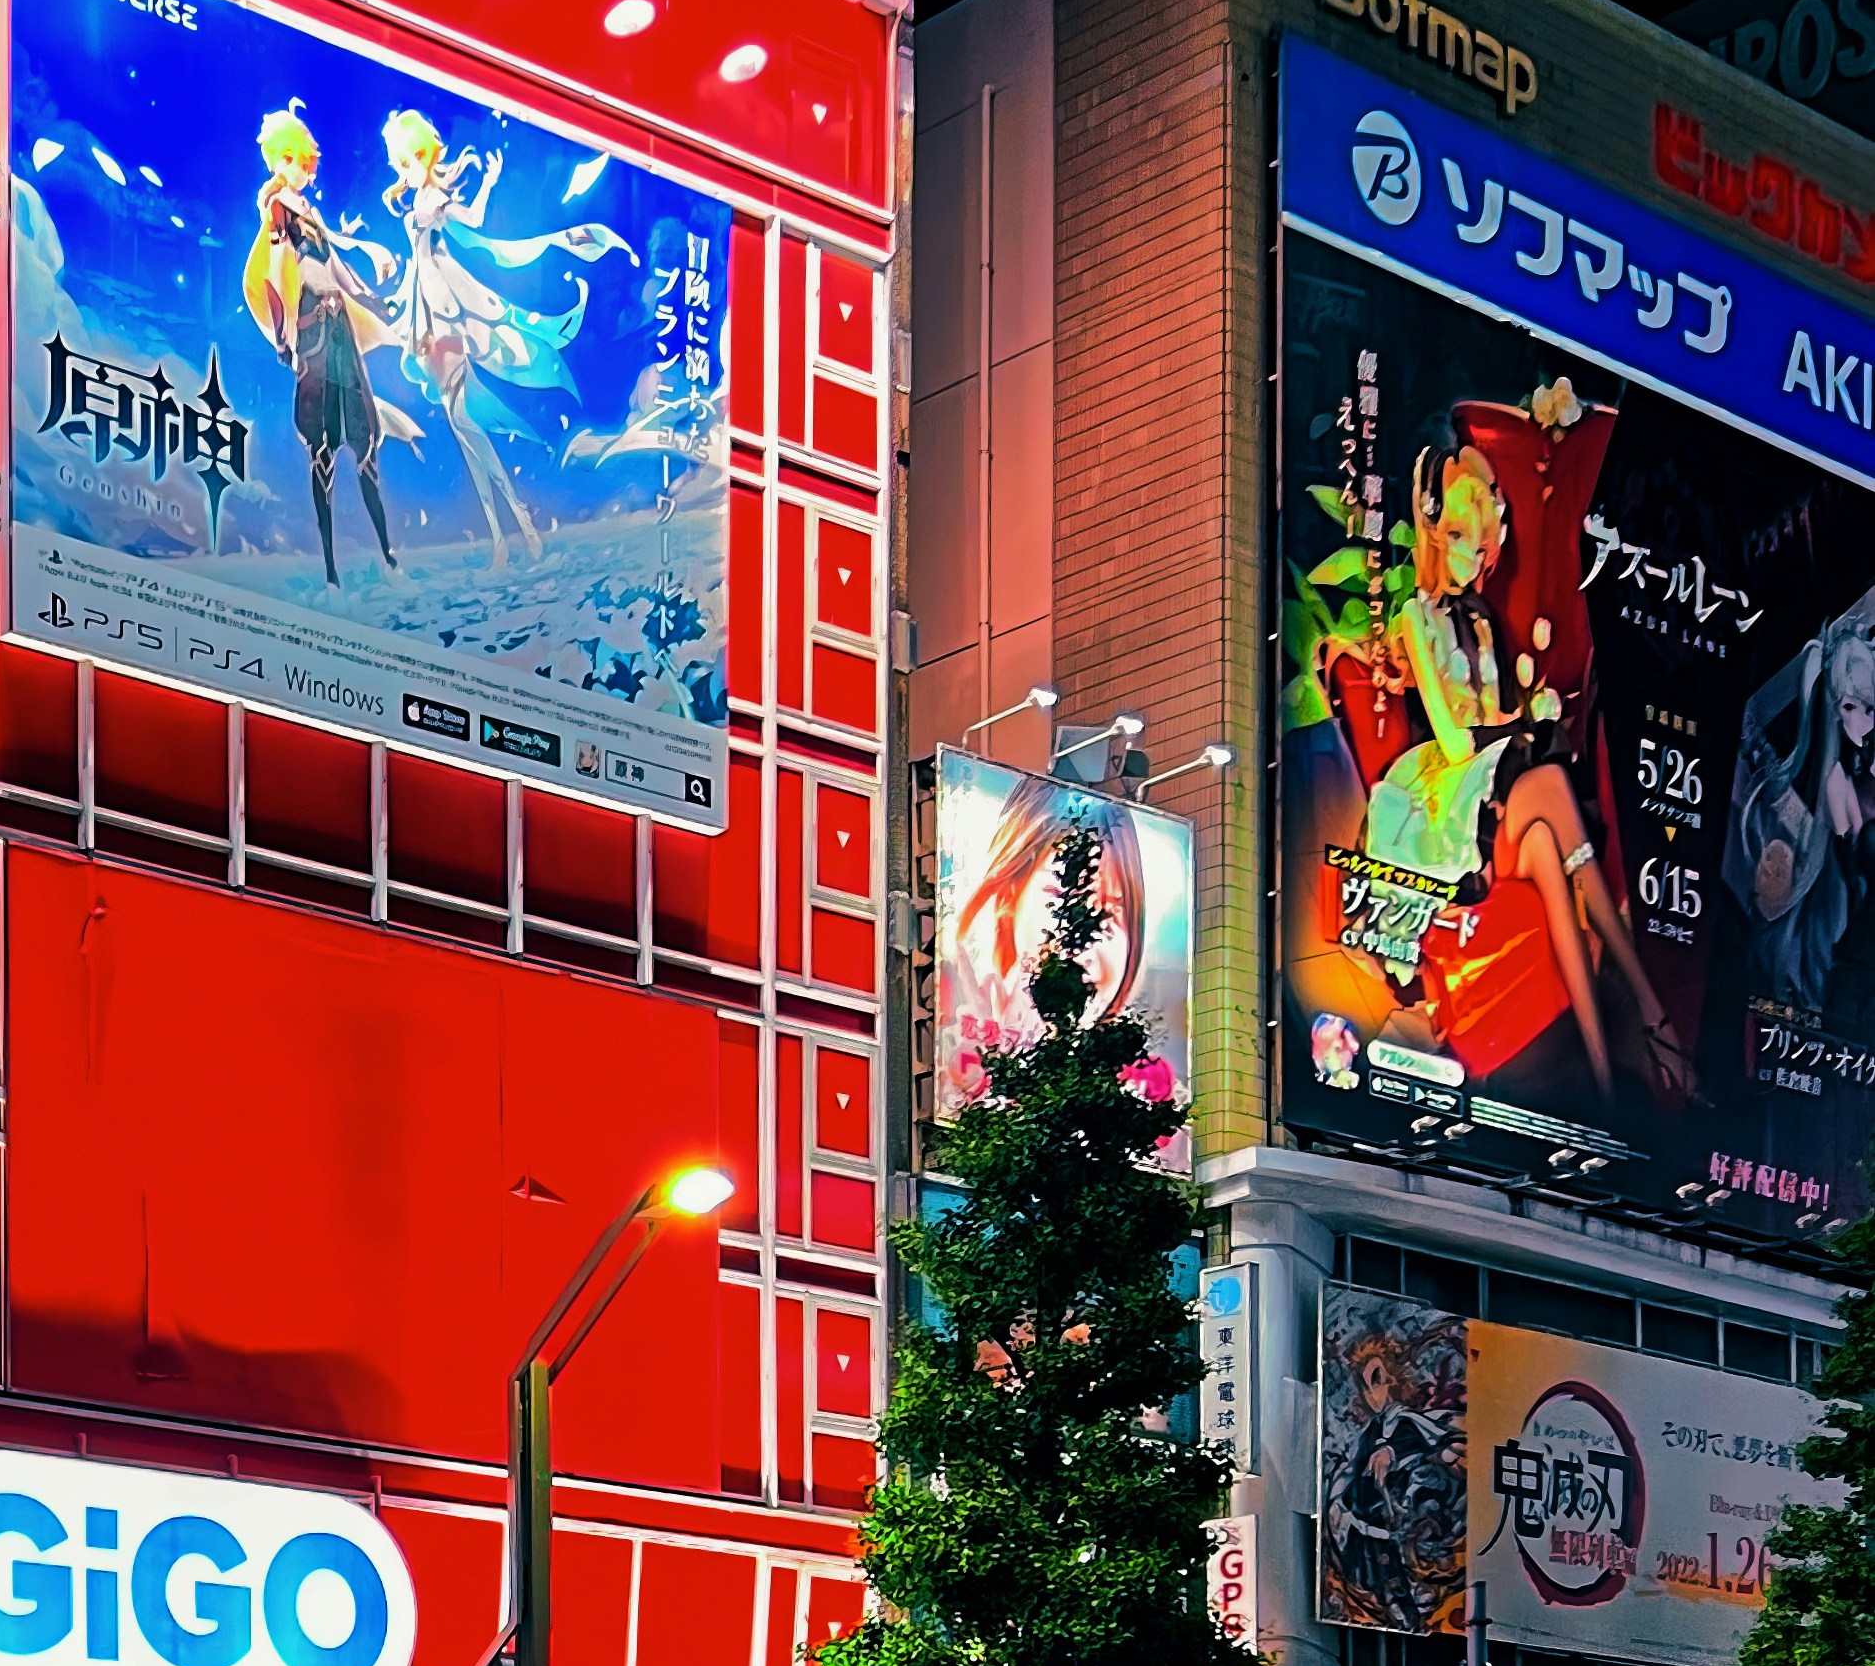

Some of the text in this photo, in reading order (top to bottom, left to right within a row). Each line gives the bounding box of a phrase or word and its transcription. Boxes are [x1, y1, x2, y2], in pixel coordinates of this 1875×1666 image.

[1442, 158, 1733, 354] ソフマップ
[37, 329, 249, 552] 原神
[83, 606, 386, 717] PS5 PS4 Windows
[1637, 737, 1704, 805] 5/26
[1342, 878, 1480, 949] ヴァンガード
[1638, 856, 1703, 918] 6/15
